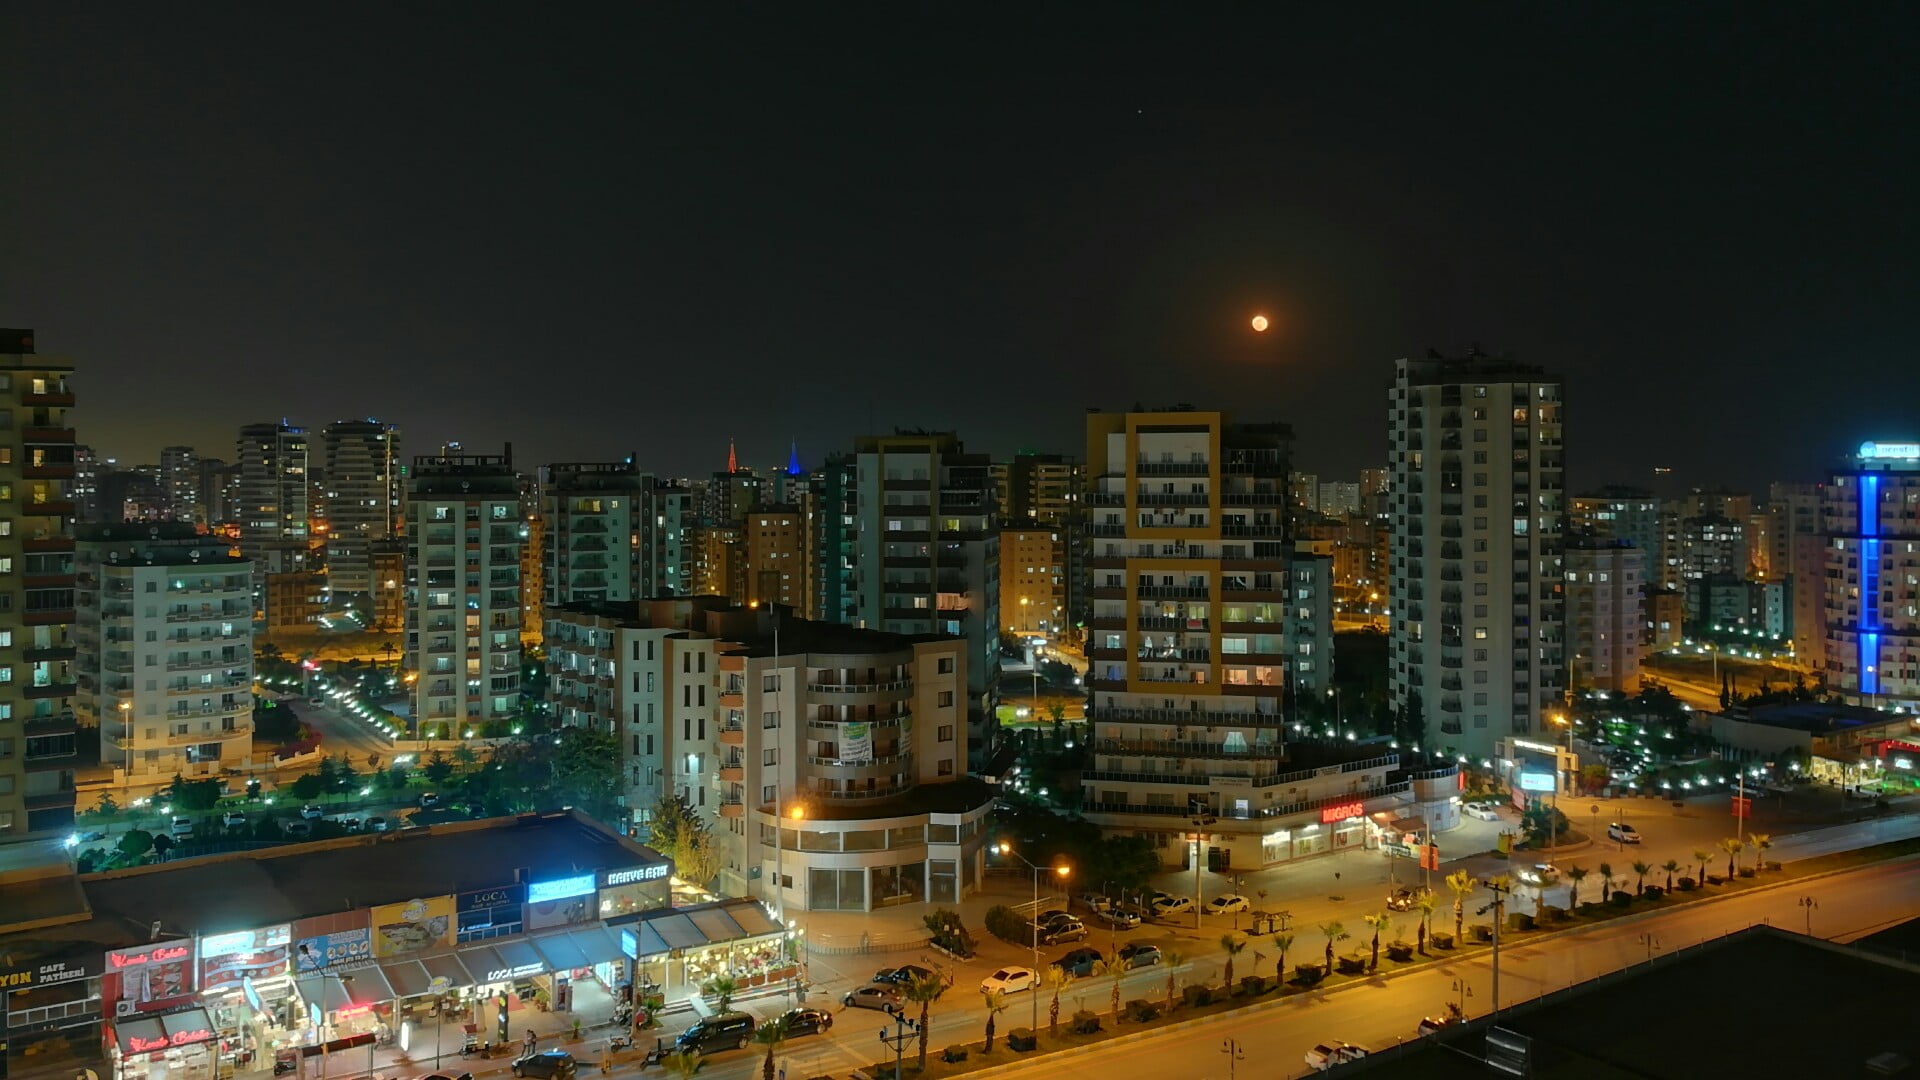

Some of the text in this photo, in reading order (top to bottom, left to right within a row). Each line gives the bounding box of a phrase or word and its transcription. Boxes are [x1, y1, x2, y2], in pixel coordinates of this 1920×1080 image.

[1322, 803, 1363, 823] MIGROS
[608, 869, 644, 885] KAHVE
[474, 891, 507, 903] LOCA
[40, 963, 65, 974] CAFE
